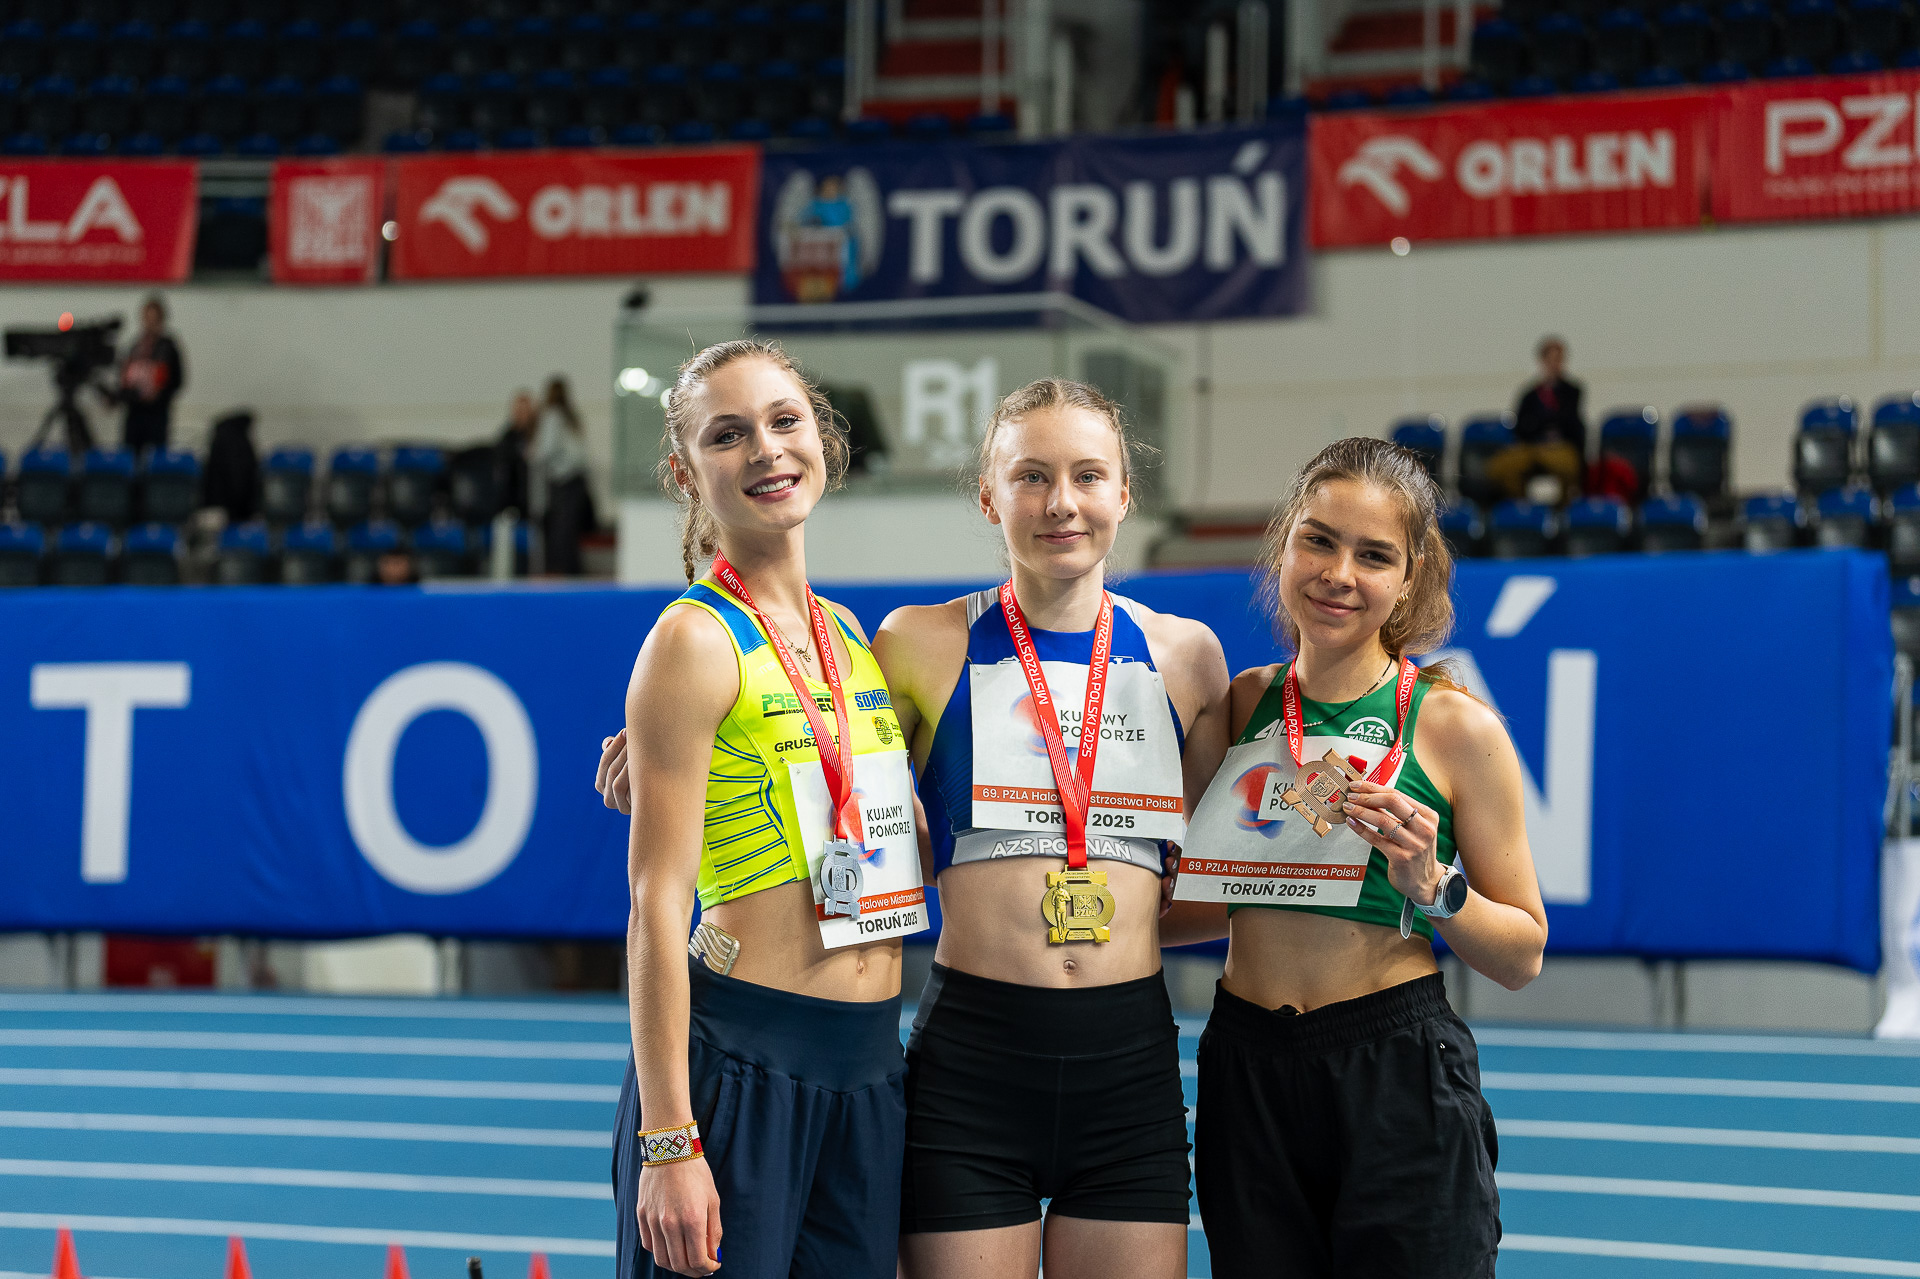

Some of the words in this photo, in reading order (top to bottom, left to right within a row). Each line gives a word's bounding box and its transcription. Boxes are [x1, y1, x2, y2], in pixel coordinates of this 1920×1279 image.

[1764, 91, 1920, 175] PZ
[1456, 129, 1676, 200] ORLEN
[0, 174, 144, 243] LA
[529, 180, 732, 240] ORLEN
[889, 141, 1288, 285] TORUŃ
[1092, 599, 1111, 680] MISTRZOSTWA
[1012, 621, 1050, 705] MISTRZOSTWA
[1087, 681, 1102, 725] POLSKI
[1061, 725, 1146, 743] POORZE
[1081, 726, 1096, 758] 2025
[1348, 735, 1388, 746] WARSZAWA
[1356, 723, 1386, 738] AZS
[982, 788, 1000, 799] 69.
[1002, 789, 1029, 801] PZLA
[1090, 794, 1143, 808] strzostwa
[1145, 797, 1177, 810] Polski
[866, 805, 903, 821] KUJAWY
[1092, 813, 1135, 829] 2025
[869, 821, 911, 839] POMORZE
[990, 837, 1034, 860] AZS
[1038, 836, 1133, 862] PONAŃ
[1188, 861, 1204, 872] 69.
[1205, 862, 1229, 873] PZLA
[1231, 864, 1267, 875] Halowe
[1269, 865, 1328, 877] Mistrzostwa
[1330, 867, 1360, 878] Polski
[1221, 880, 1275, 896] TORUŃ
[1277, 884, 1317, 898] 2025
[860, 897, 889, 911] Halowe
[856, 911, 902, 935] TORUŃ
[902, 911, 918, 928] 2025
